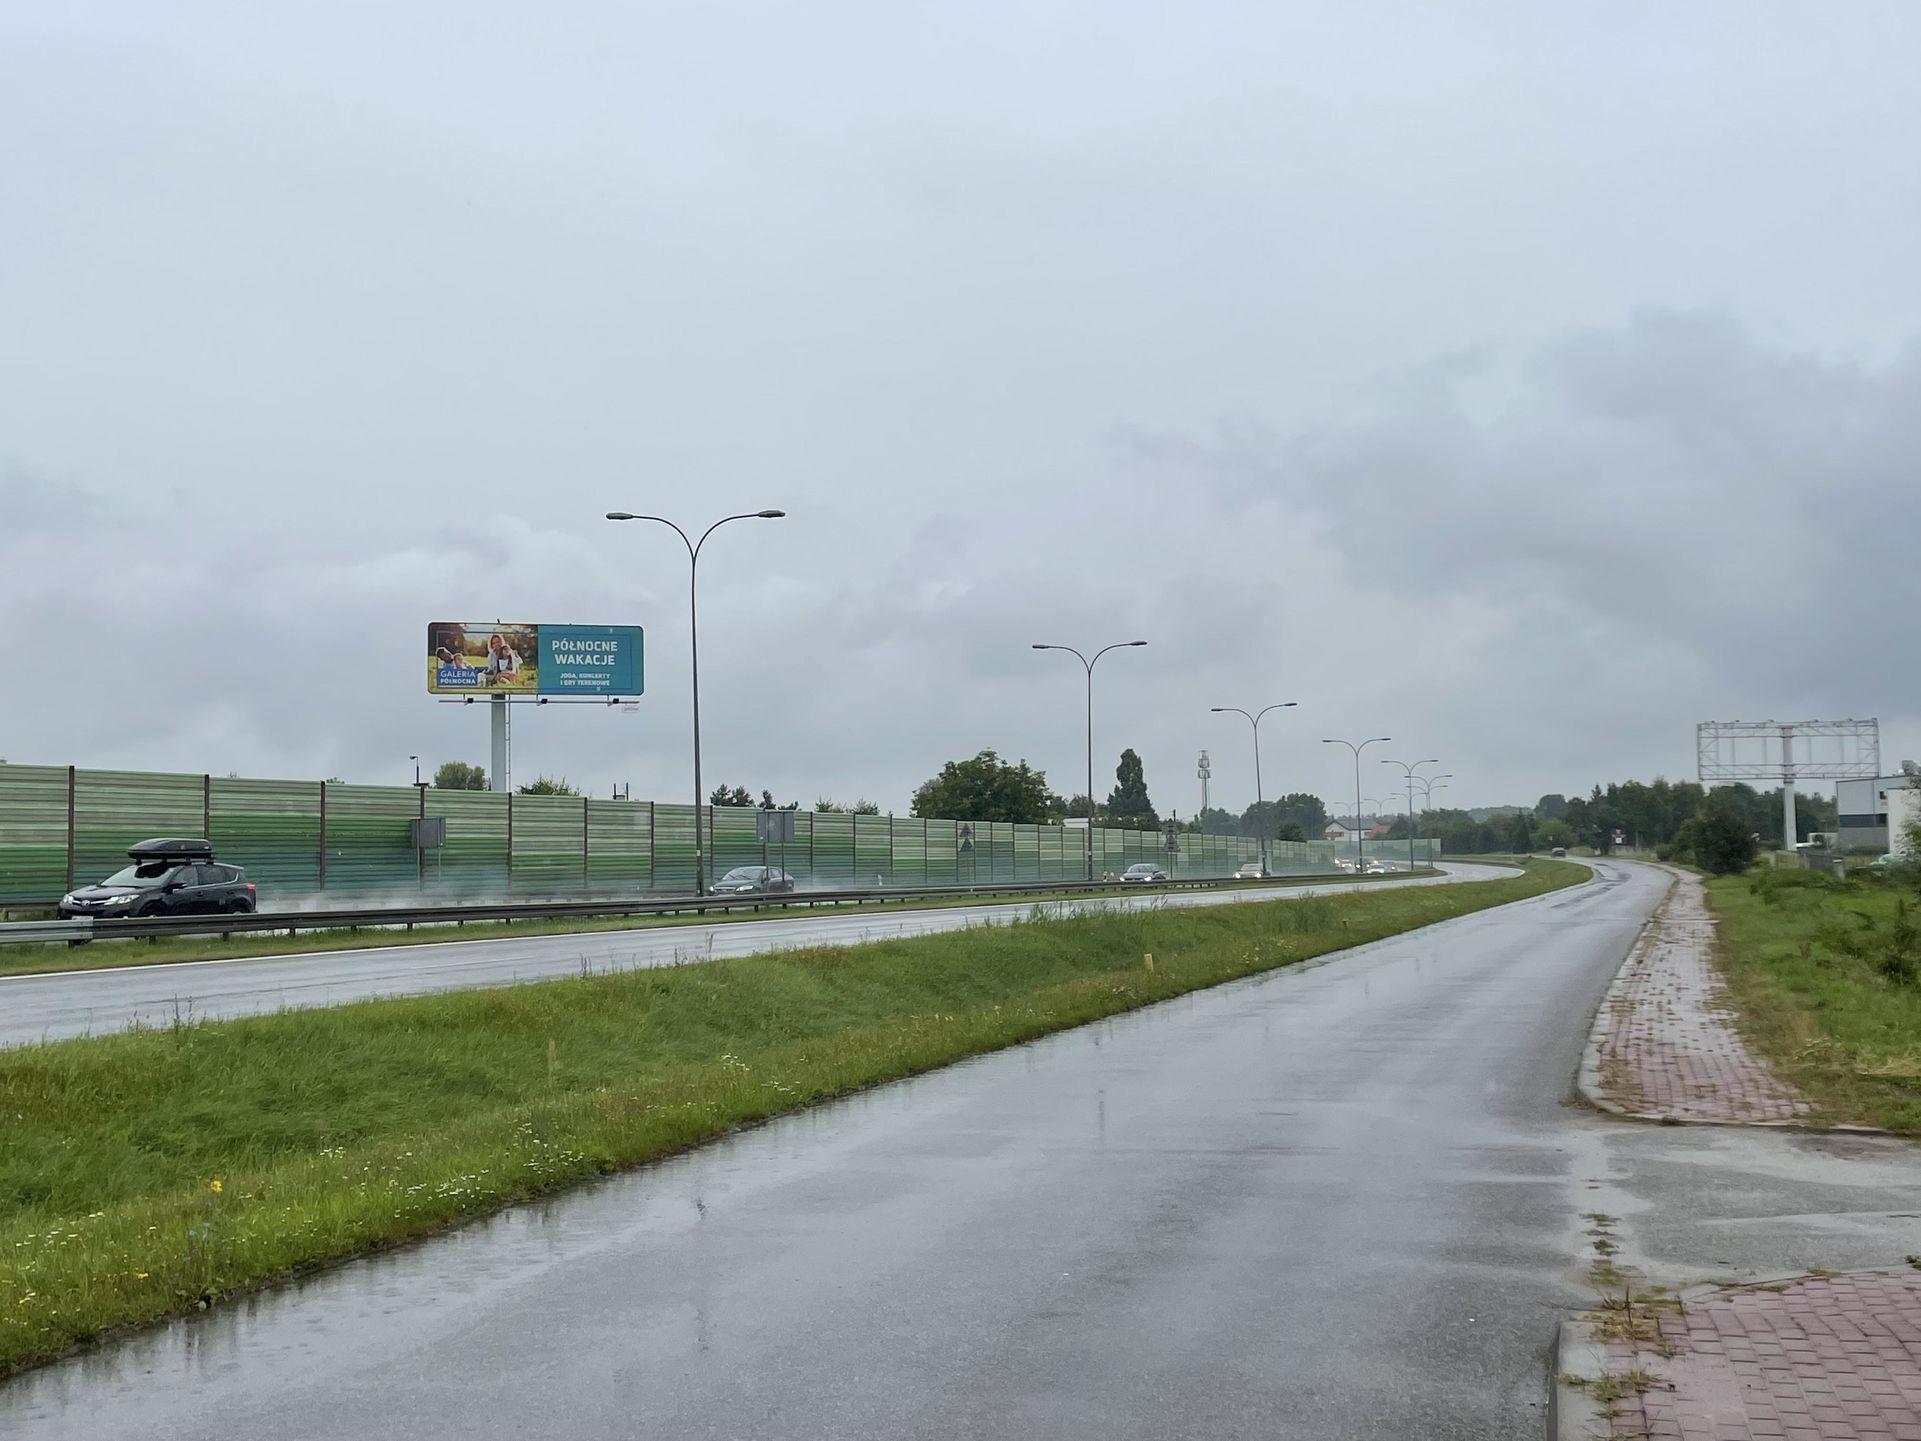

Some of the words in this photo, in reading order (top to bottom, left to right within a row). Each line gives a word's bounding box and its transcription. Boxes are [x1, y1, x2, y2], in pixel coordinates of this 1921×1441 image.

[552, 638, 618, 652] PÓŁNOCNE
[555, 654, 615, 665] WAKACJE
[440, 670, 476, 678] GALERIA
